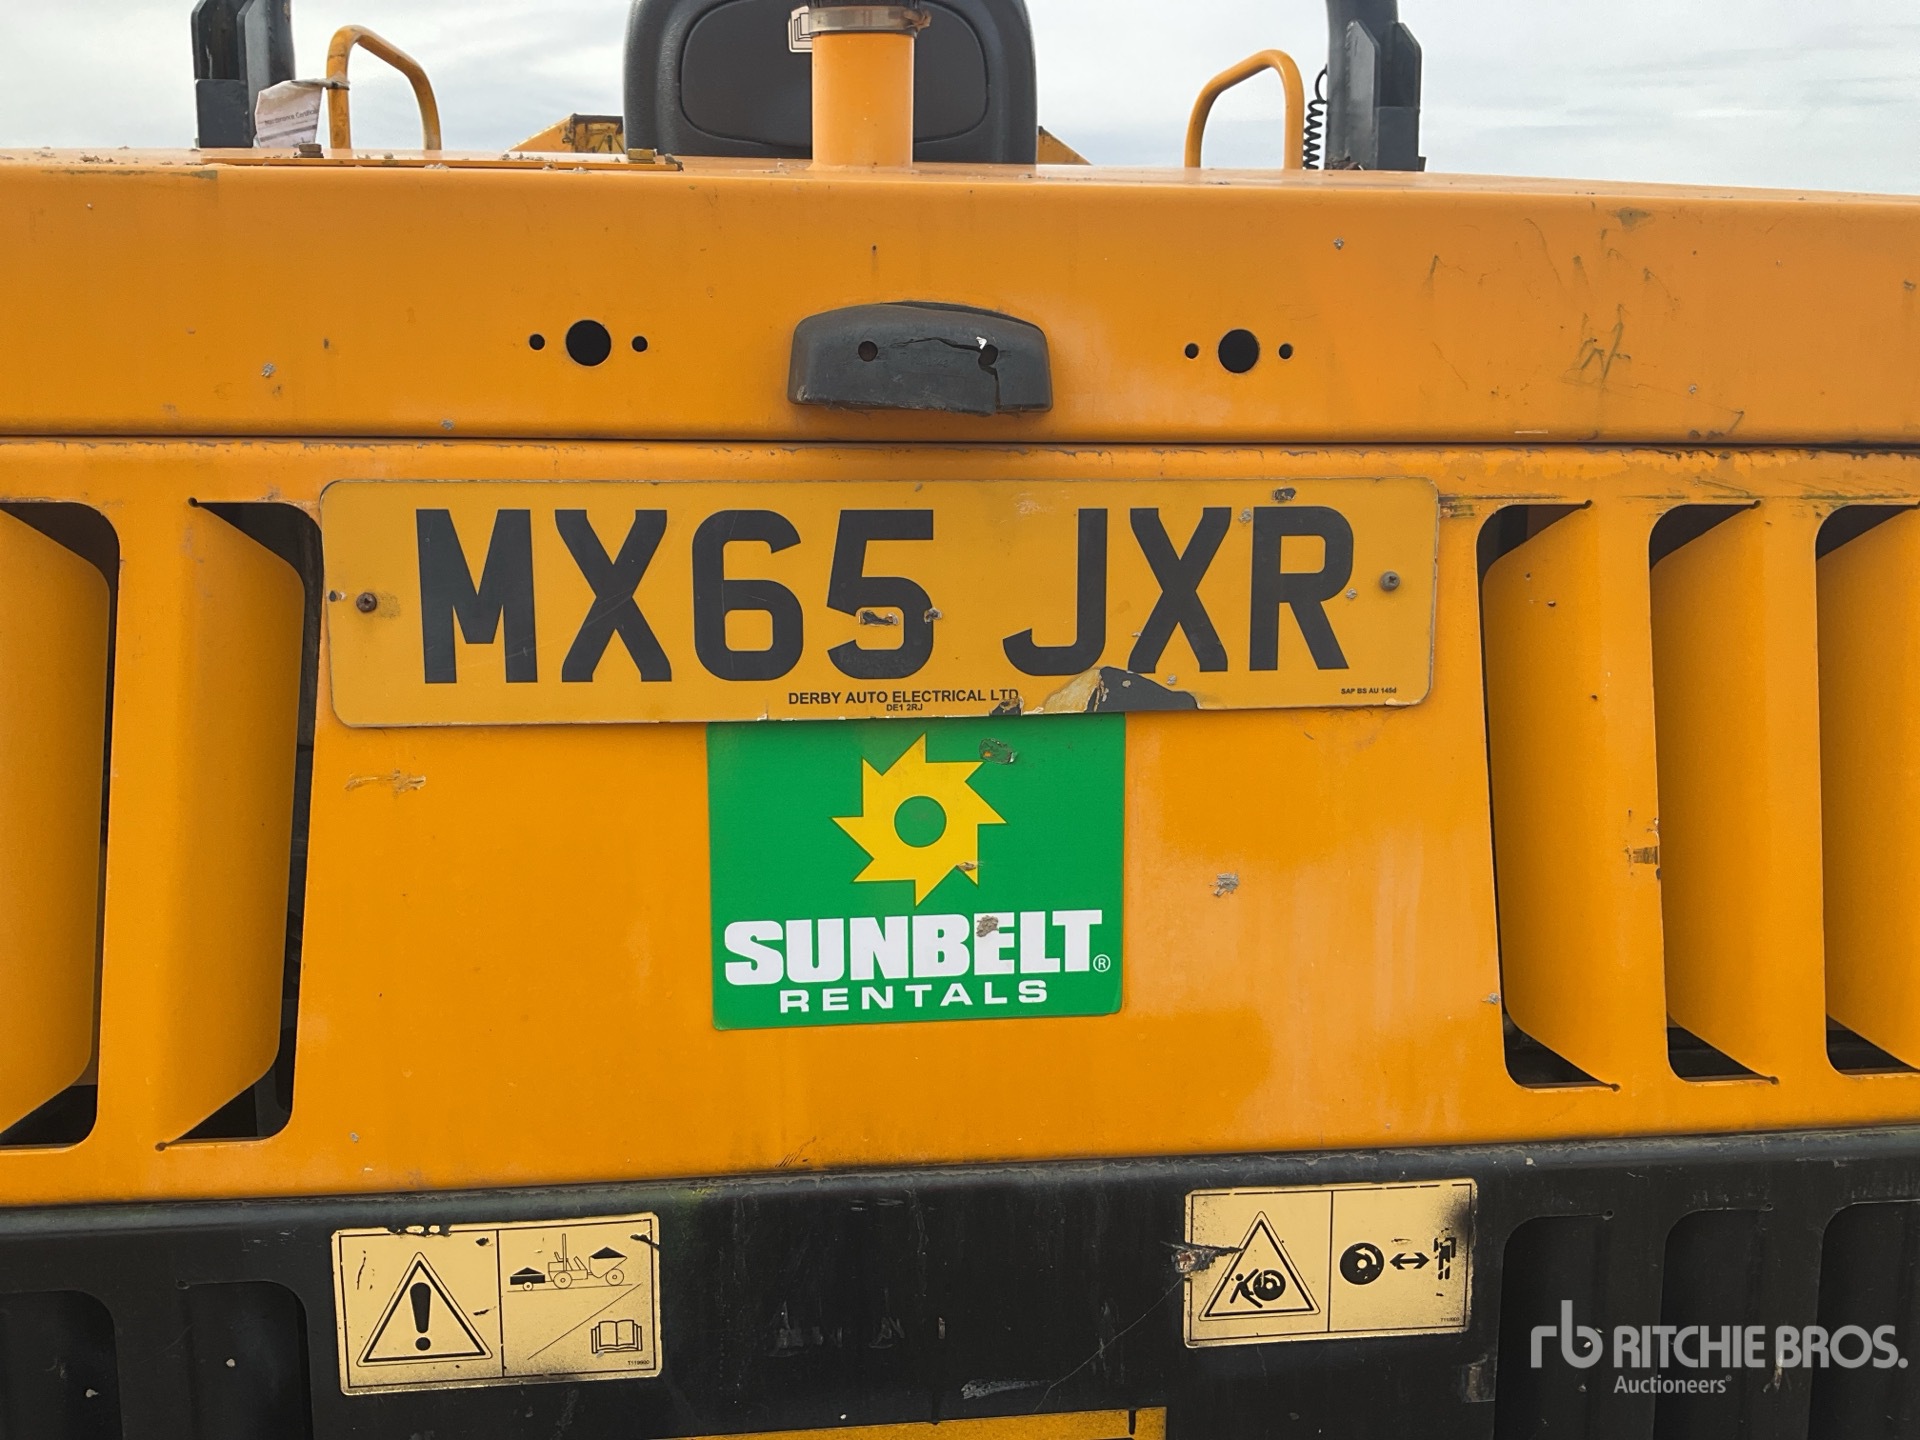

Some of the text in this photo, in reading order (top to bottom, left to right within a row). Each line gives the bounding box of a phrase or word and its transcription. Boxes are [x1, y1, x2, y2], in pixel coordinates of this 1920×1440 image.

[416, 506, 1354, 684] MX65 JXR
[788, 688, 1019, 704] DERBY AUTO ELECTRICAL LTD
[886, 703, 923, 711] DE1 2RJ
[780, 979, 1047, 1013] RENTALS
